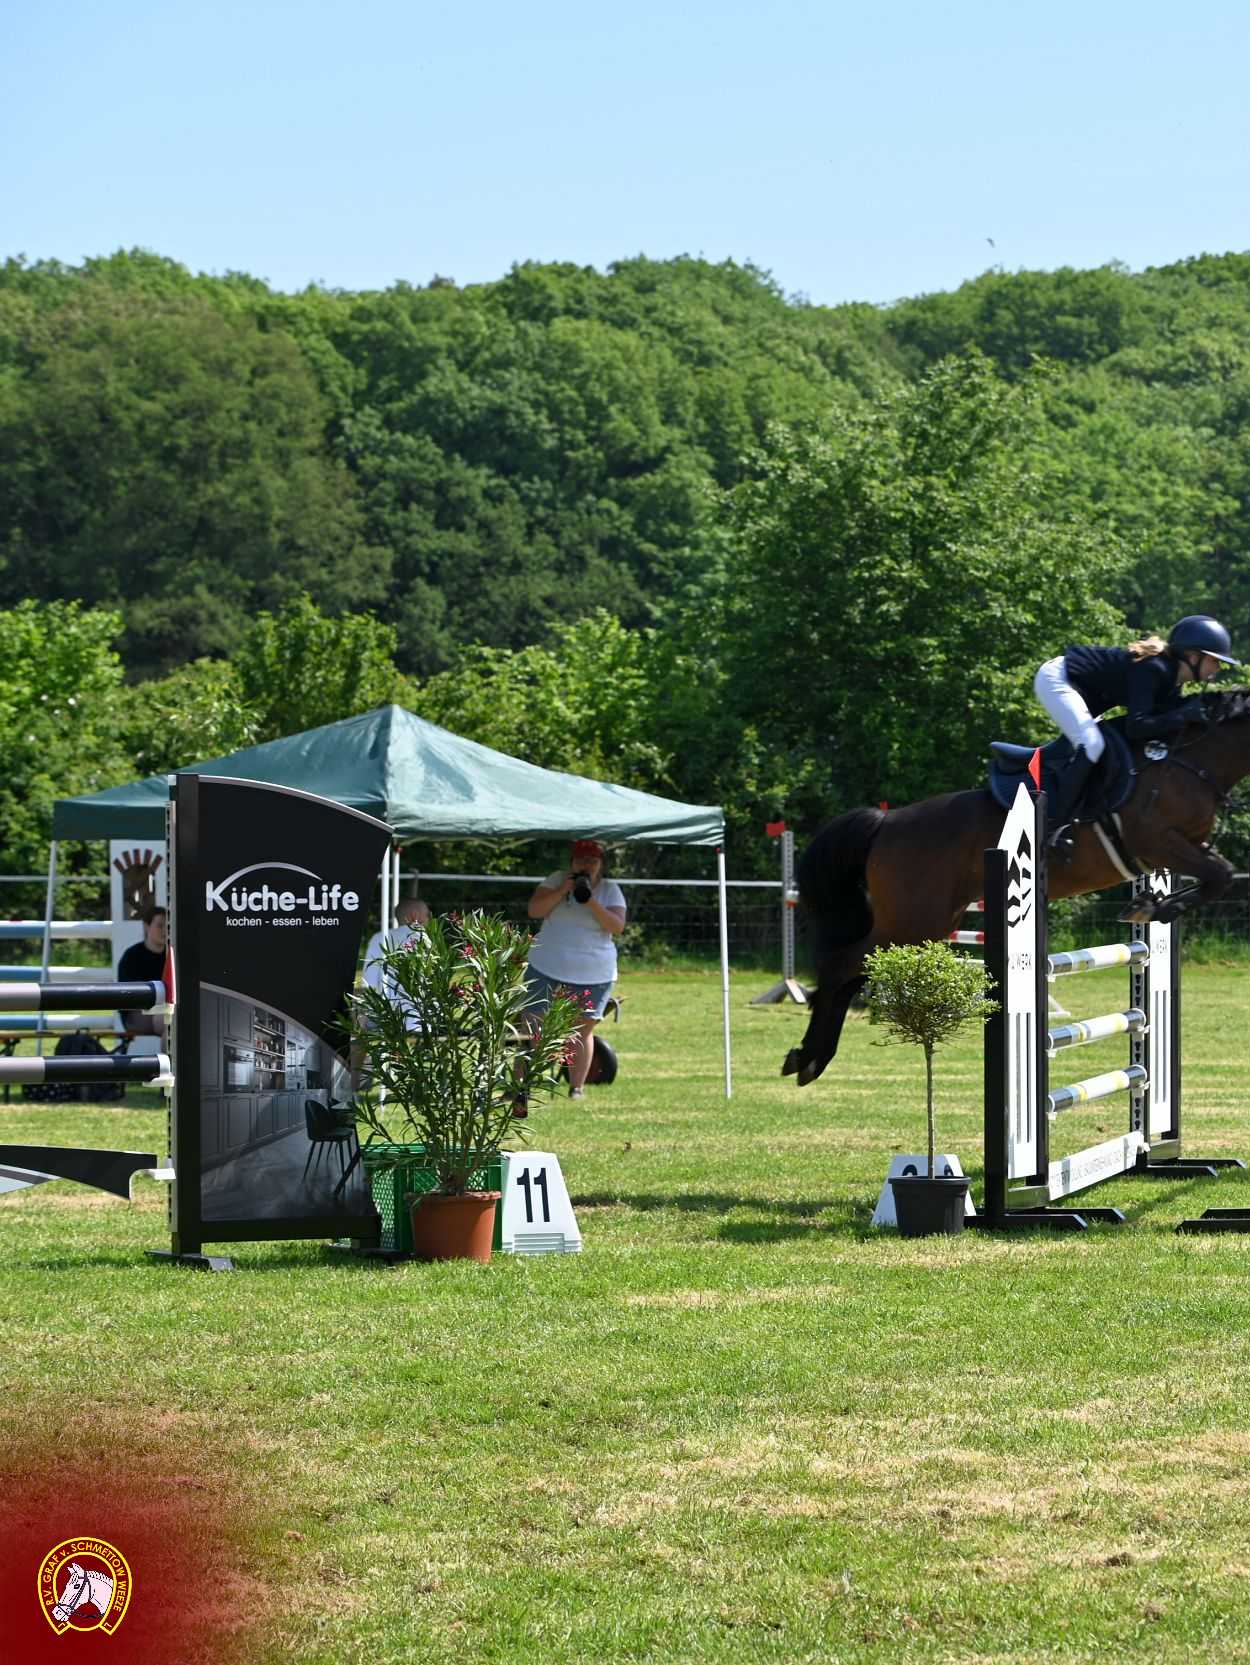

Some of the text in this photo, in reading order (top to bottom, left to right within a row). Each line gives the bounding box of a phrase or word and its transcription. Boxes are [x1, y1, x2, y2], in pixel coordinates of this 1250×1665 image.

[206, 880, 360, 912] Küche-Life
[226, 916, 262, 927] kochen
[272, 917, 302, 927] essen
[312, 916, 339, 927] leben
[516, 1167, 551, 1223] 11
